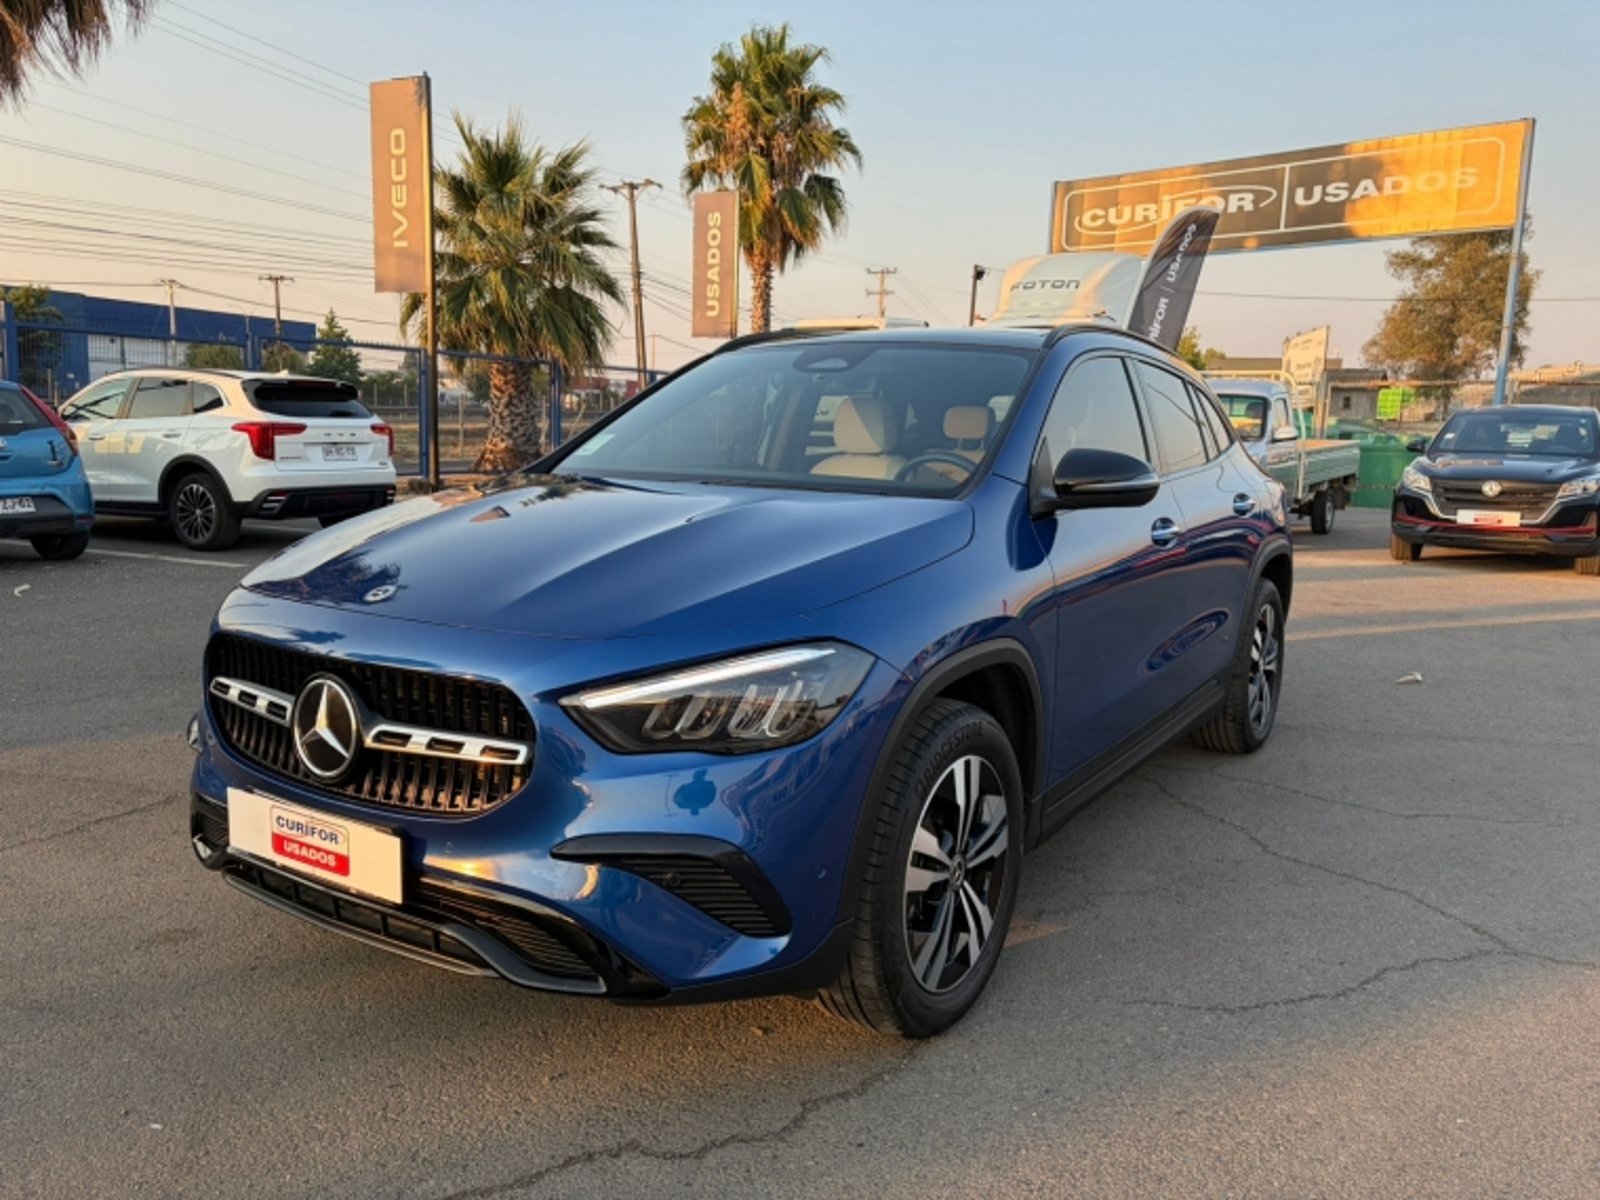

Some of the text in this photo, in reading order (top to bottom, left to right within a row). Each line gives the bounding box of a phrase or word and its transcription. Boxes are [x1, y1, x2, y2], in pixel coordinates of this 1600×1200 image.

[390, 128, 409, 248] IVECO
[1081, 167, 1479, 228] CURIFOR USADOS
[706, 211, 722, 317] USADOS
[1010, 279, 1081, 292] FOTON
[275, 815, 340, 845] CURIFOR
[283, 840, 337, 867] USADOS
